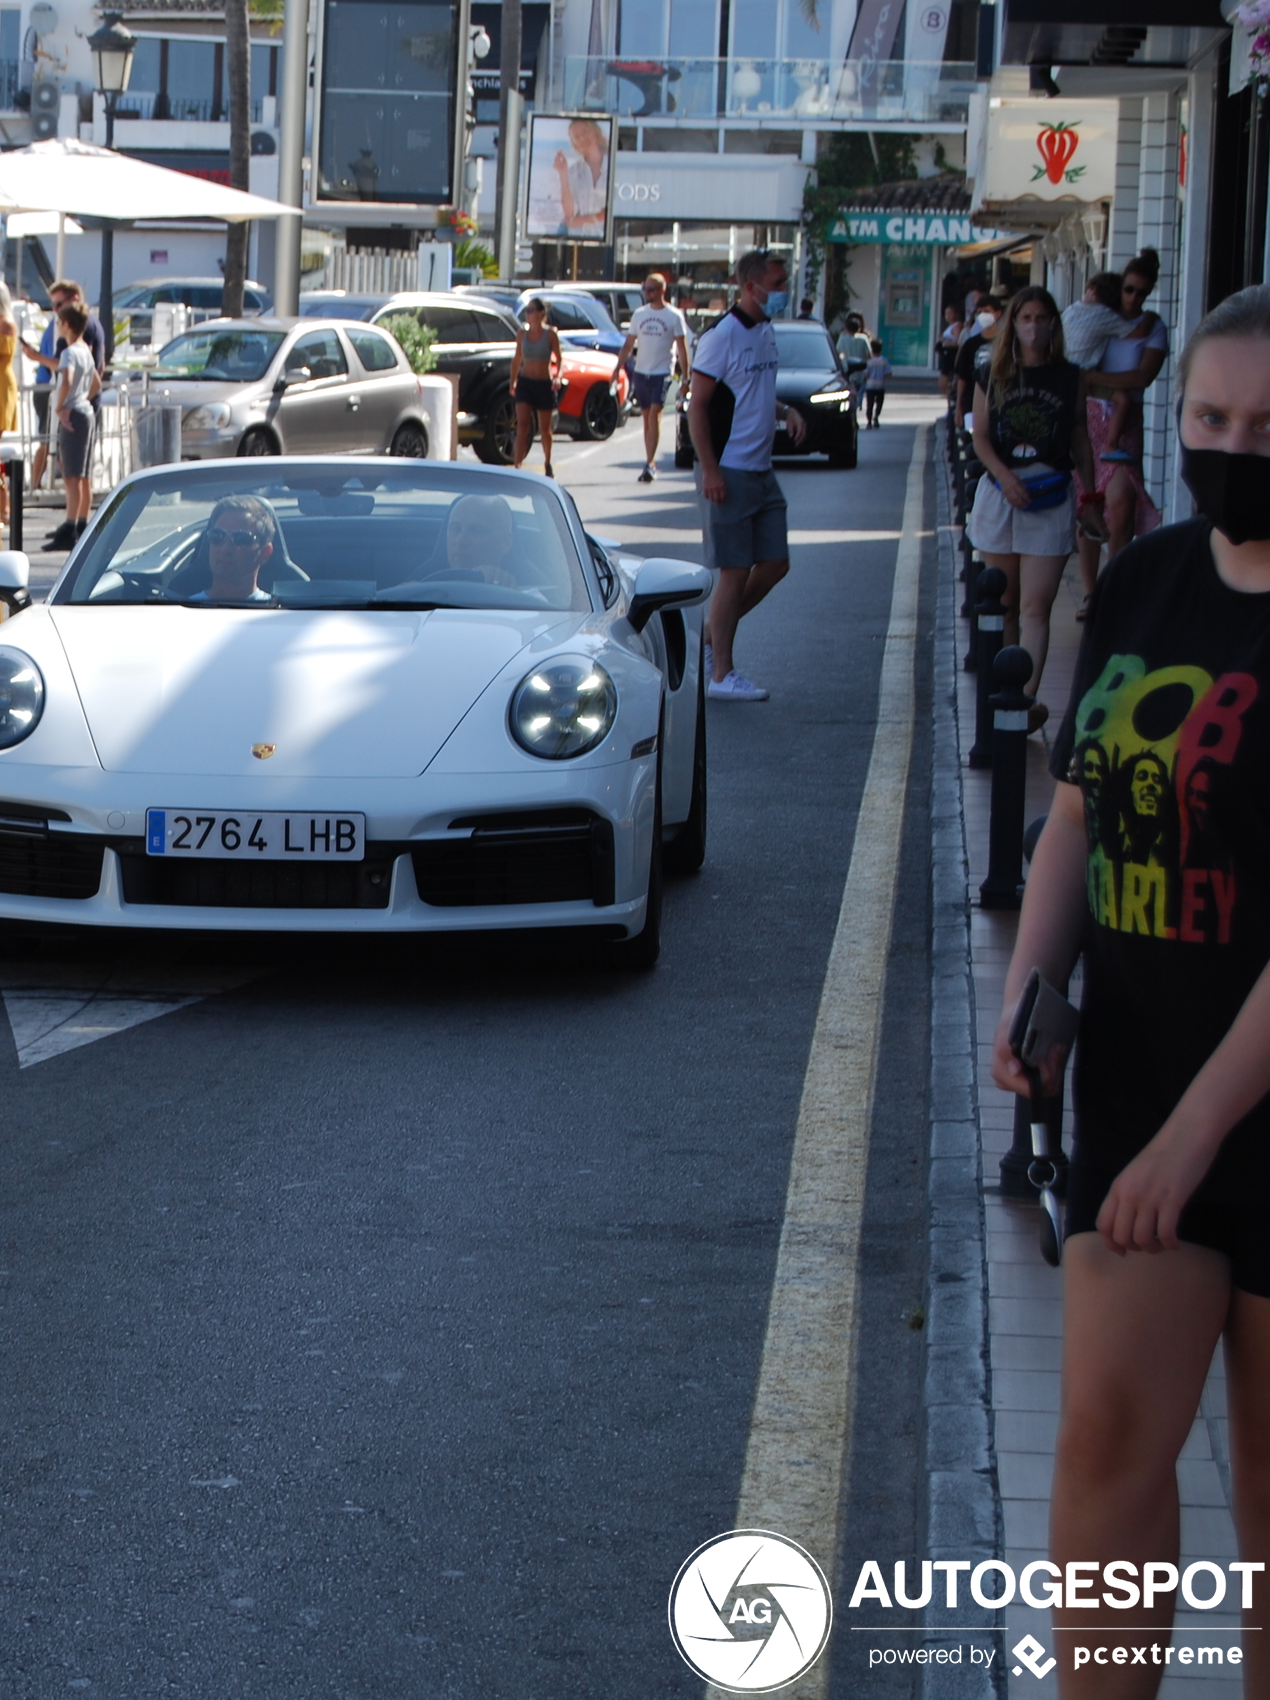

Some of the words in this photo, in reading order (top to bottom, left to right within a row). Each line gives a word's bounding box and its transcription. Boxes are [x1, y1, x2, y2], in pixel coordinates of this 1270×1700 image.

[614, 182, 661, 202] OD'S
[832, 219, 879, 237] ATM
[886, 217, 1011, 242] CHANG
[1075, 654, 1259, 775] BOB
[152, 836, 161, 847] E
[172, 816, 268, 852] 2764
[284, 818, 357, 853] LHB
